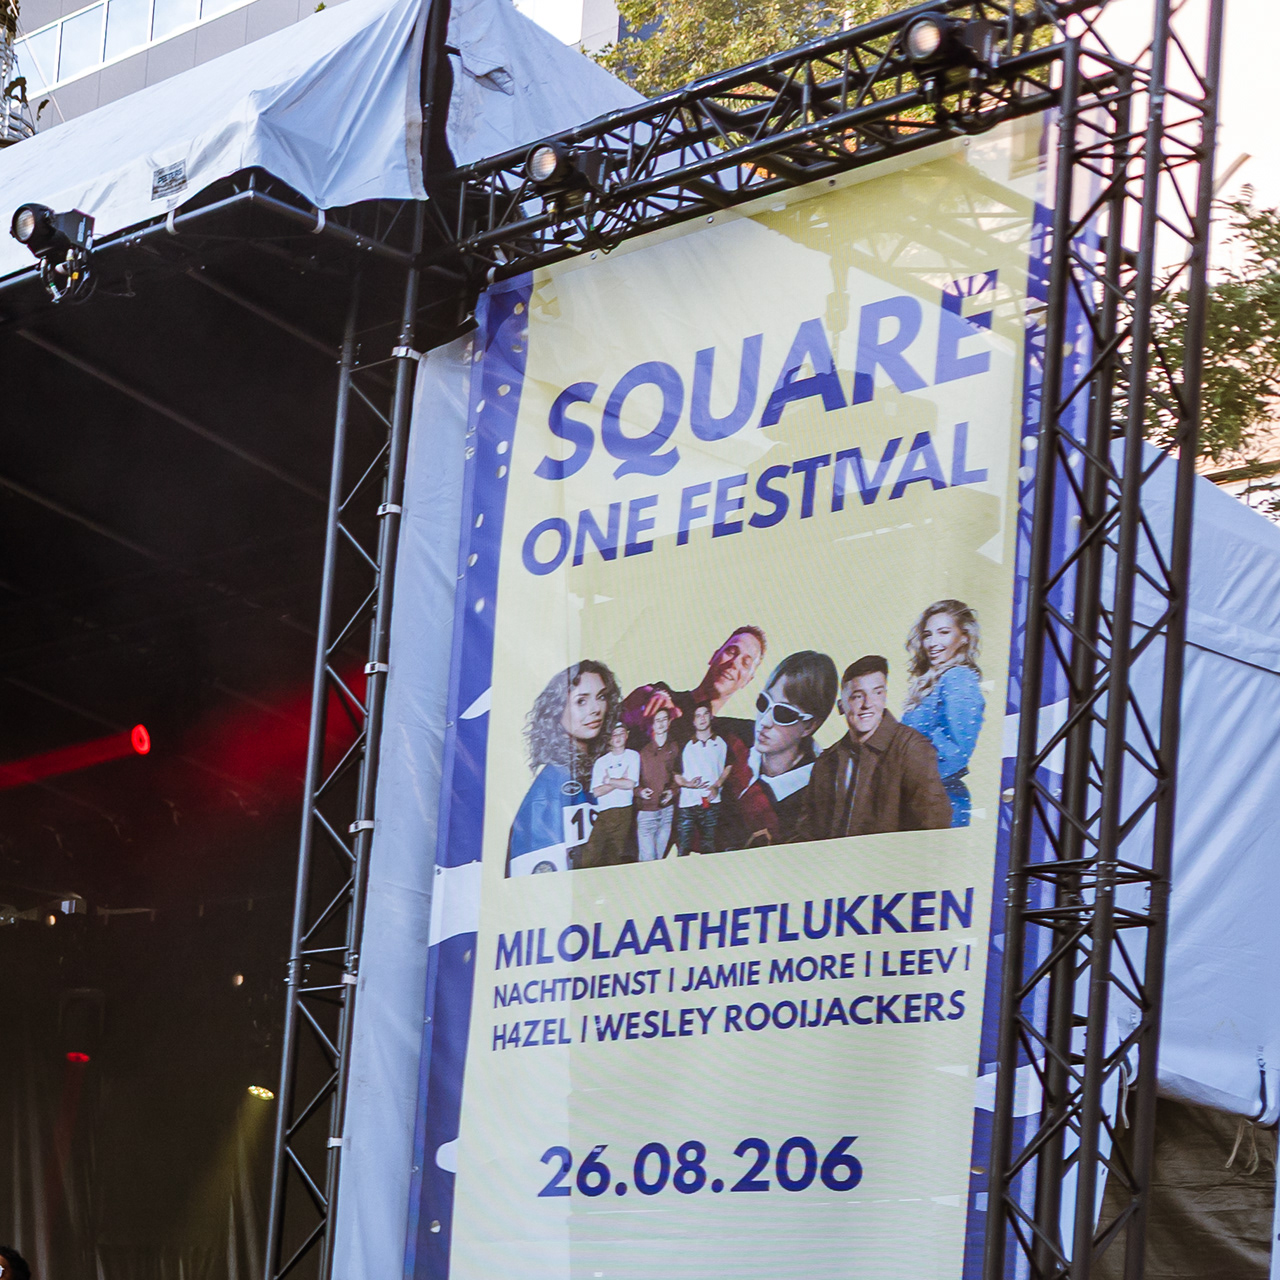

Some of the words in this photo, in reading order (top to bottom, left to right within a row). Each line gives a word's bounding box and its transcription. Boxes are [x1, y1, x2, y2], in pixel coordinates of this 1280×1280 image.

[533, 269, 999, 480] SQUARE
[522, 494, 658, 577] ONE
[676, 421, 988, 547] FESTIVAL
[495, 887, 974, 970] MILOLAATHETLUKKEN
[493, 969, 661, 1009] NACHTDIENST
[681, 960, 761, 992] JAMIE
[768, 953, 855, 984] MORE
[882, 947, 958, 977] LEEV
[492, 1018, 571, 1051] H4ZEL
[595, 1006, 718, 1042] WESLEY
[724, 990, 966, 1033] ROOIJACKERS
[537, 1136, 863, 1198] 26.08.206
